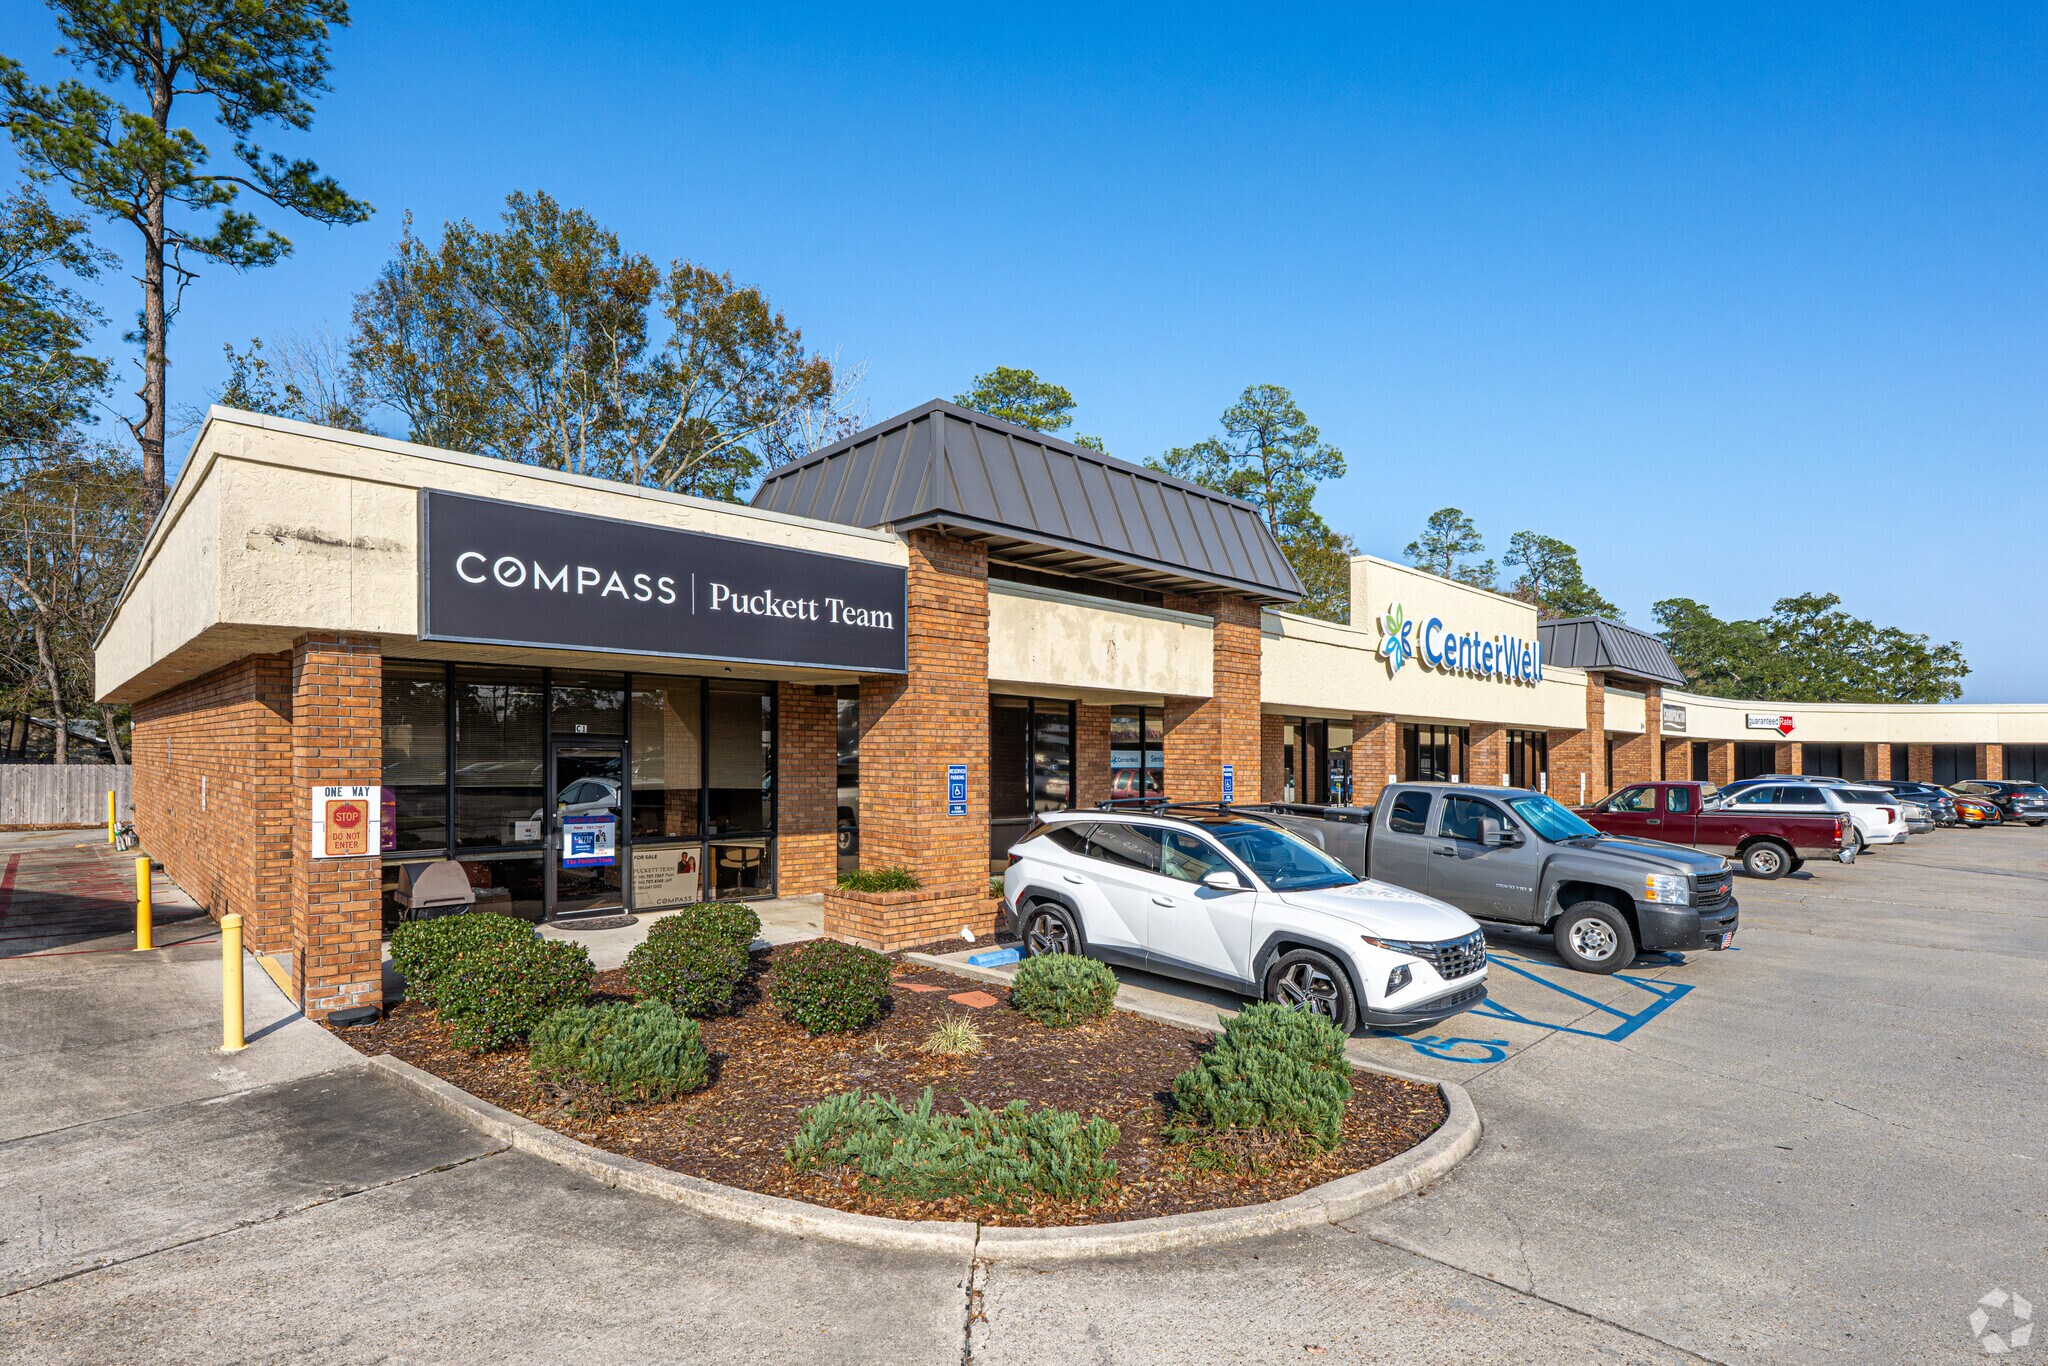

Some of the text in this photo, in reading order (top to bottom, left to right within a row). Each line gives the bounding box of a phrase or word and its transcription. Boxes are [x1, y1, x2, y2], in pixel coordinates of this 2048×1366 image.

[456, 551, 895, 630] COMPASS Puckett Team
[1424, 616, 1543, 682] CenterWell
[1779, 716, 1793, 726] Rate
[325, 787, 370, 797] ONE WAY
[335, 812, 359, 821] STOP
[334, 841, 359, 849] ENTER
[656, 896, 692, 905] COMPASS
